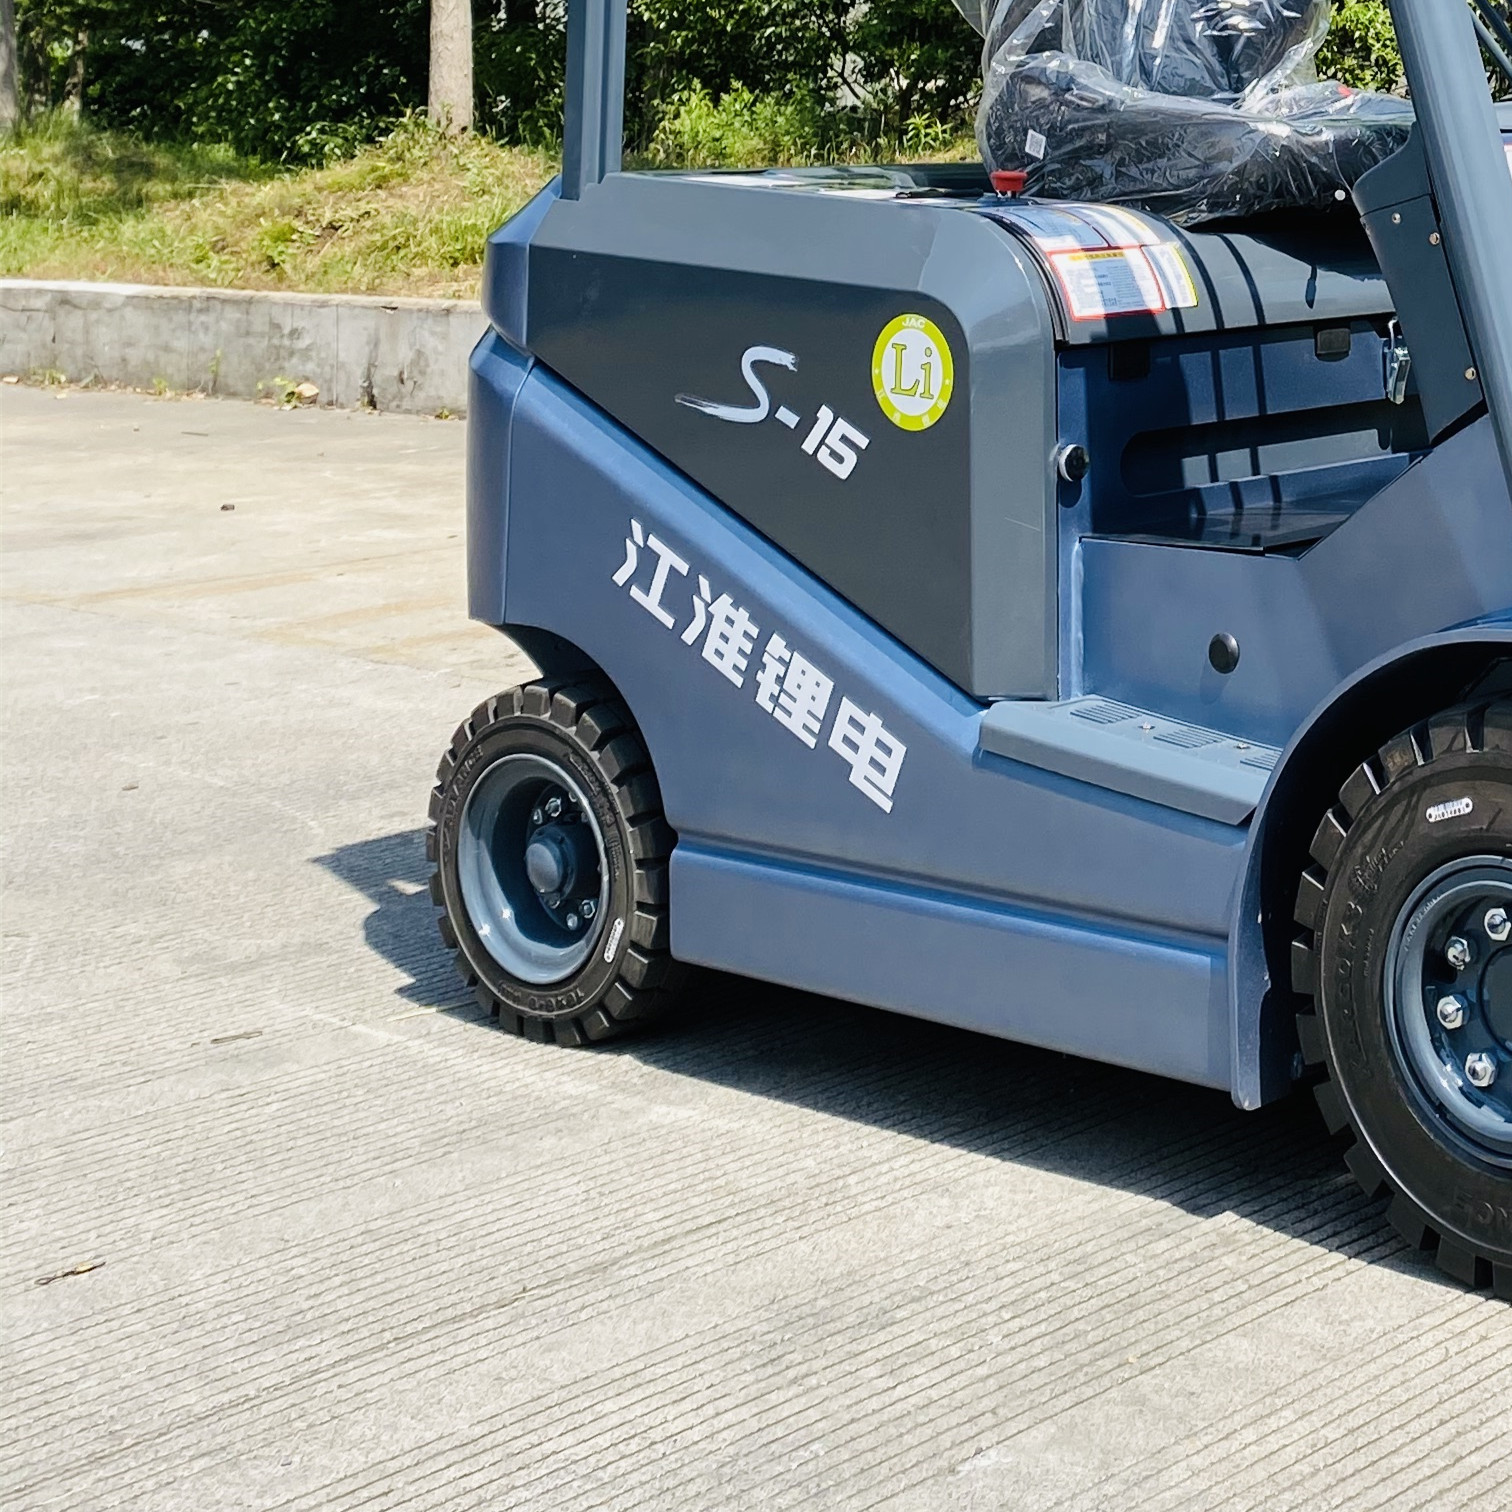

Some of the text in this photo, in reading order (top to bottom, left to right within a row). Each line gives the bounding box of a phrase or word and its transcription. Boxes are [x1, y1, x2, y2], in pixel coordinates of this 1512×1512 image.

[902, 316, 926, 329] JAC
[890, 343, 934, 400] Li
[612, 518, 907, 814] 江淮锂电
